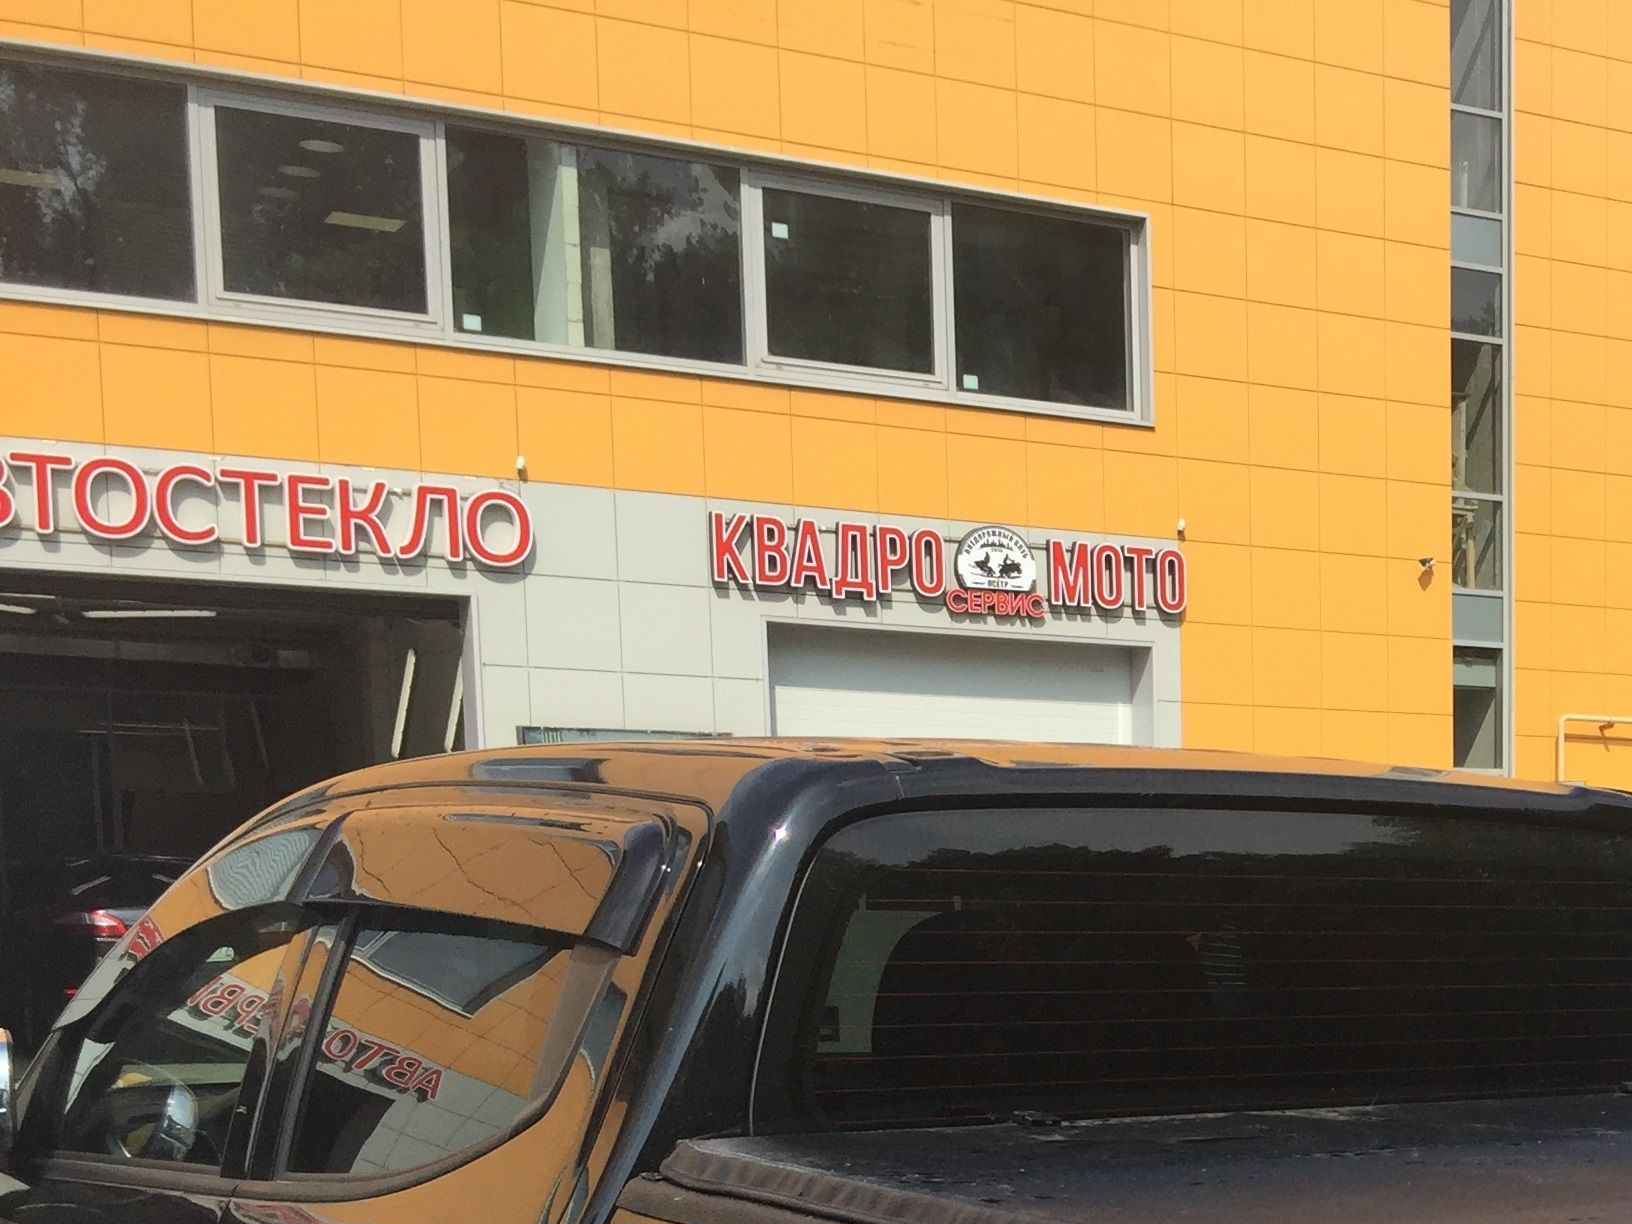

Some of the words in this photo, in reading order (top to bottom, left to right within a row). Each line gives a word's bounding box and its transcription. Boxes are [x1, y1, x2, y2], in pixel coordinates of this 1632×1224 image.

[0, 451, 534, 567] ТОСТЕКЛО
[709, 510, 946, 601] КВАДРО
[1047, 538, 1187, 614] МОТО
[946, 588, 1046, 617] СЕРВИС
